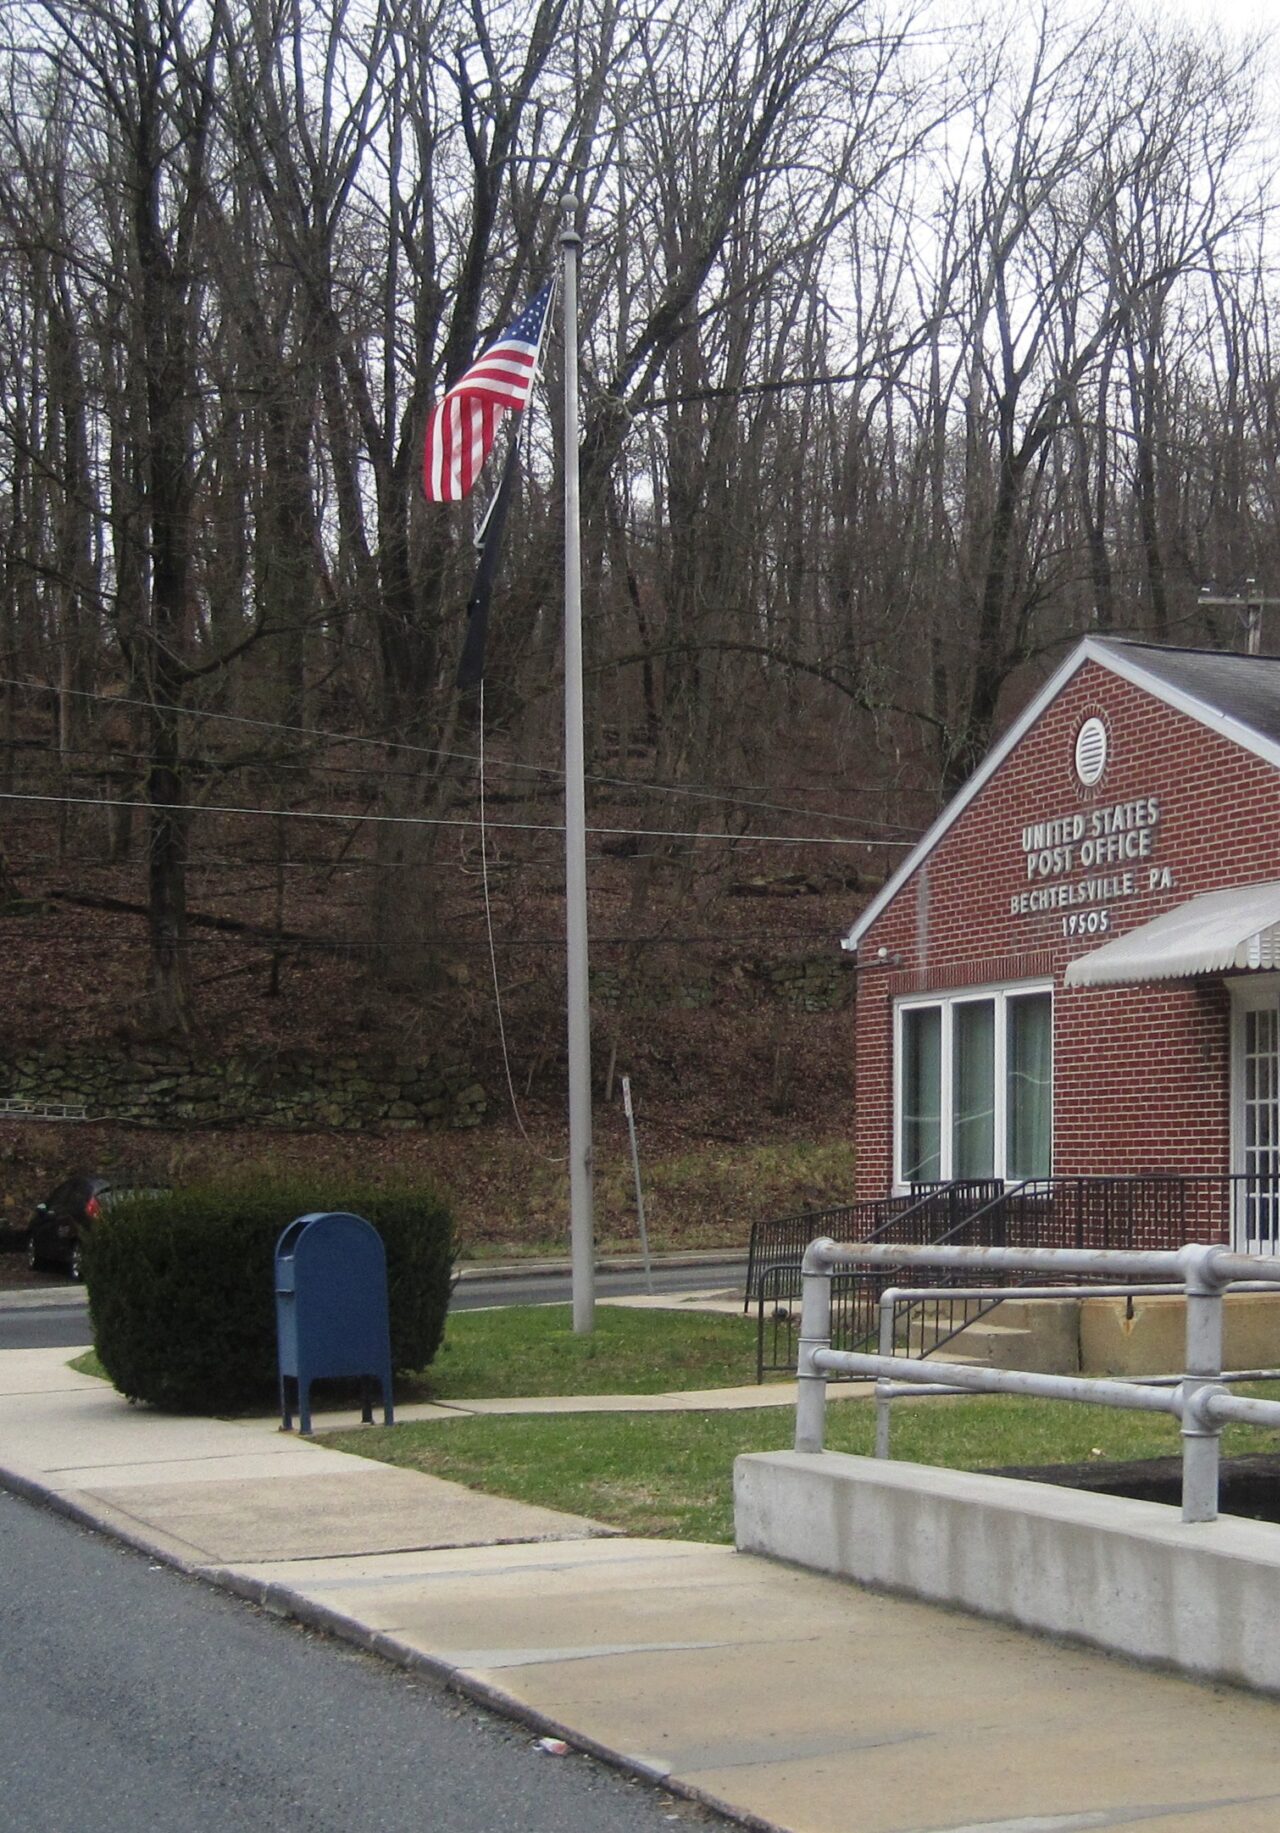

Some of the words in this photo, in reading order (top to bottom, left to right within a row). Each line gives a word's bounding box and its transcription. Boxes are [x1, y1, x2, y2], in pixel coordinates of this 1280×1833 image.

[1022, 814, 1086, 852] UNITED
[1092, 797, 1160, 837] STATES
[1028, 846, 1074, 880] POST
[1081, 828, 1152, 867] OFFICE
[1062, 910, 1109, 937] 19505
